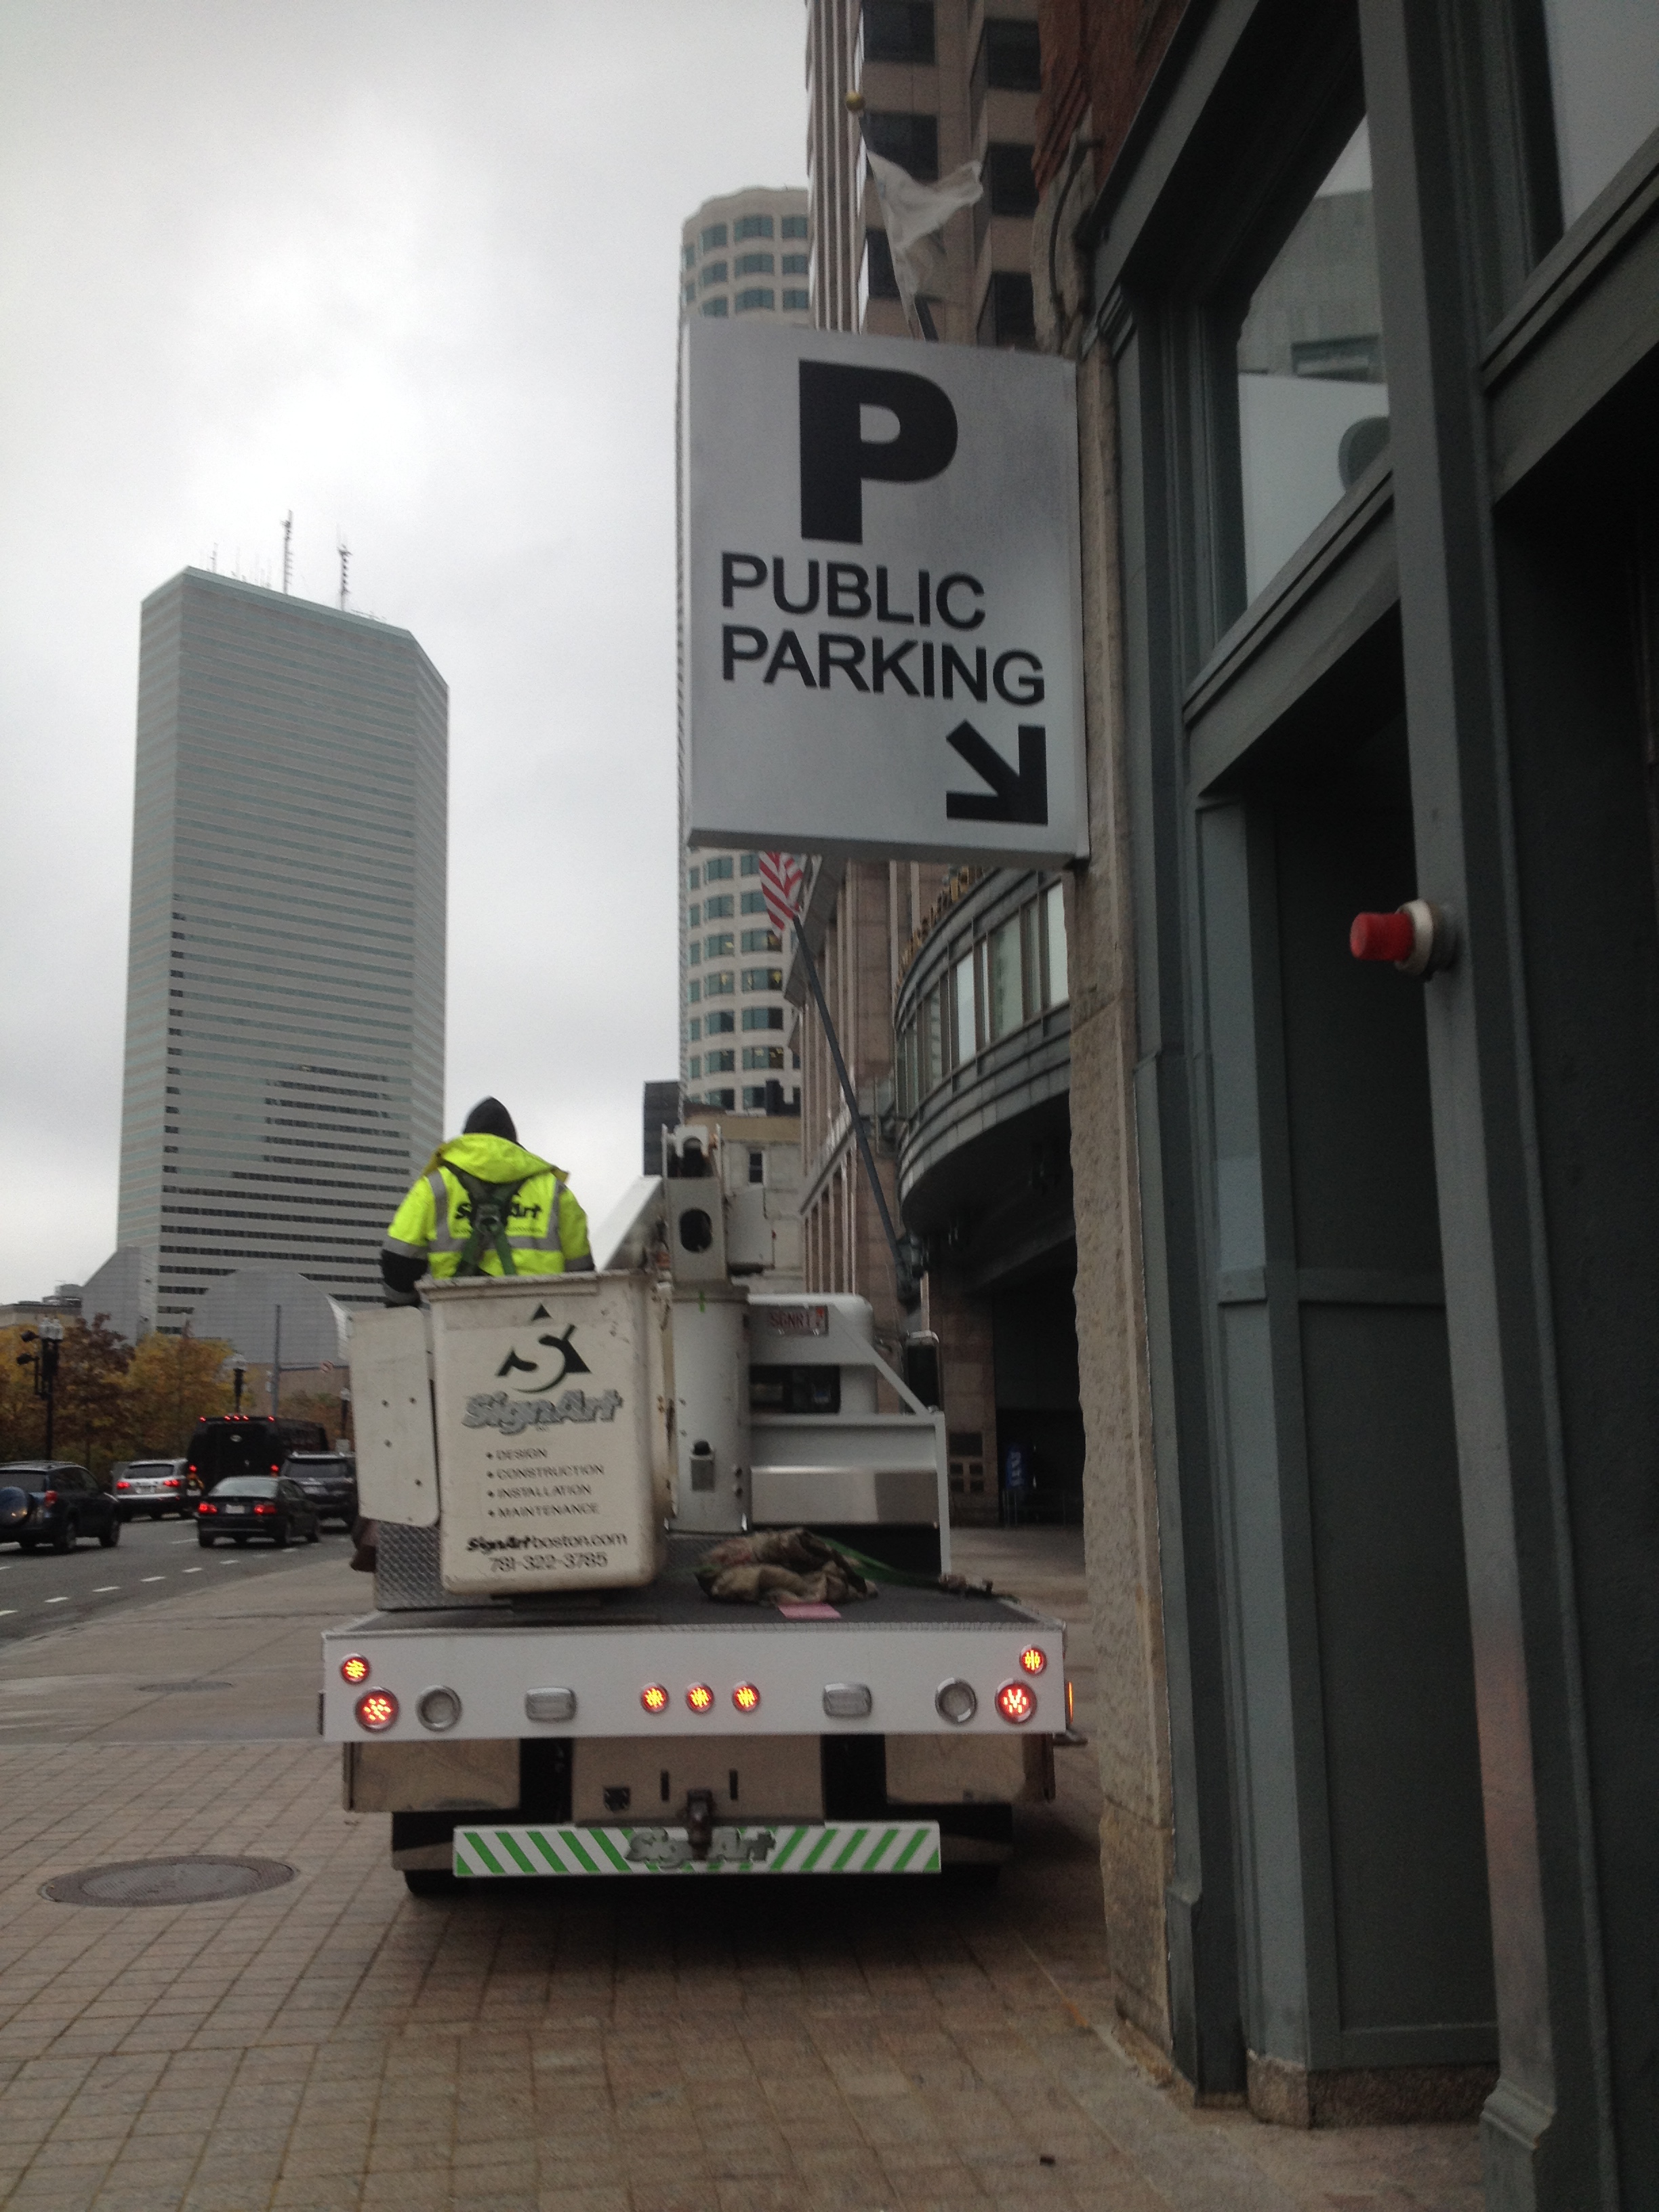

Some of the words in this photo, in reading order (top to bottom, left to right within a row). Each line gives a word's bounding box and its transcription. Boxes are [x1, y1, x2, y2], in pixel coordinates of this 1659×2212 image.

[799, 359, 958, 544] P
[722, 551, 985, 631] PUBLIC
[722, 624, 1046, 705] PARKING
[461, 1389, 623, 1436] SignArt
[495, 1448, 548, 1460] DESIGN
[497, 1464, 605, 1480] CONSTRUCTION
[497, 1484, 592, 1499] INSTALLATION
[498, 1502, 600, 1518] MAINTENANCE
[489, 1552, 609, 1572] 781-322-3785
